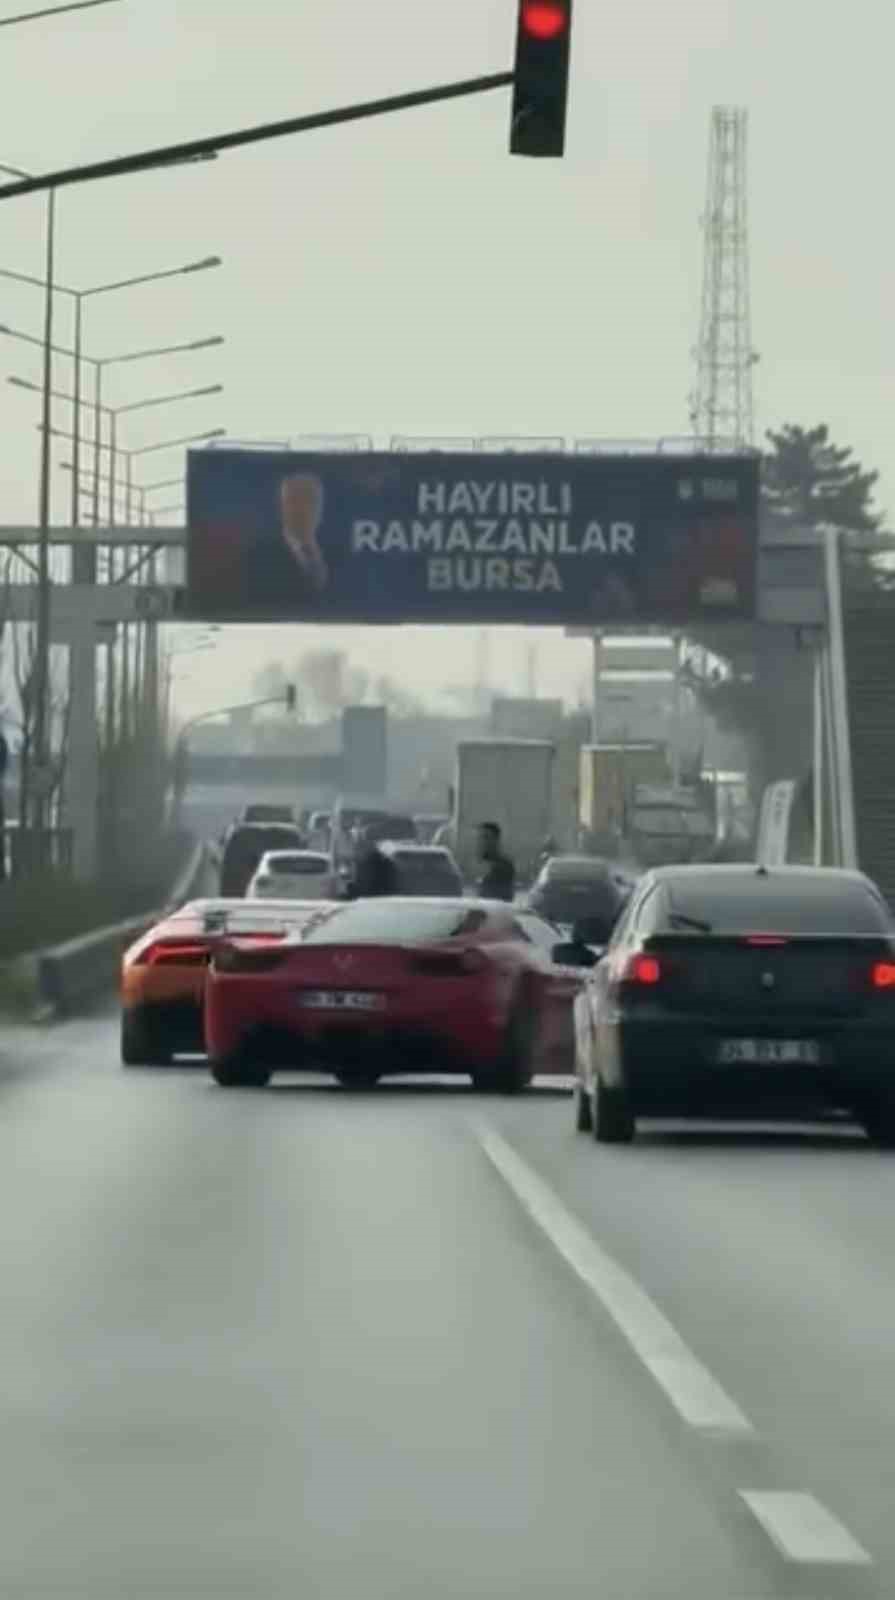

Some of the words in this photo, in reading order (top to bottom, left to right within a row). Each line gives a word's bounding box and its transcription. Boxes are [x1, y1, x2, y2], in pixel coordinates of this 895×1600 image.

[418, 482, 571, 514] HAYIRLI
[353, 519, 636, 553] RAMAZANLAR
[428, 558, 562, 591] BURSA
